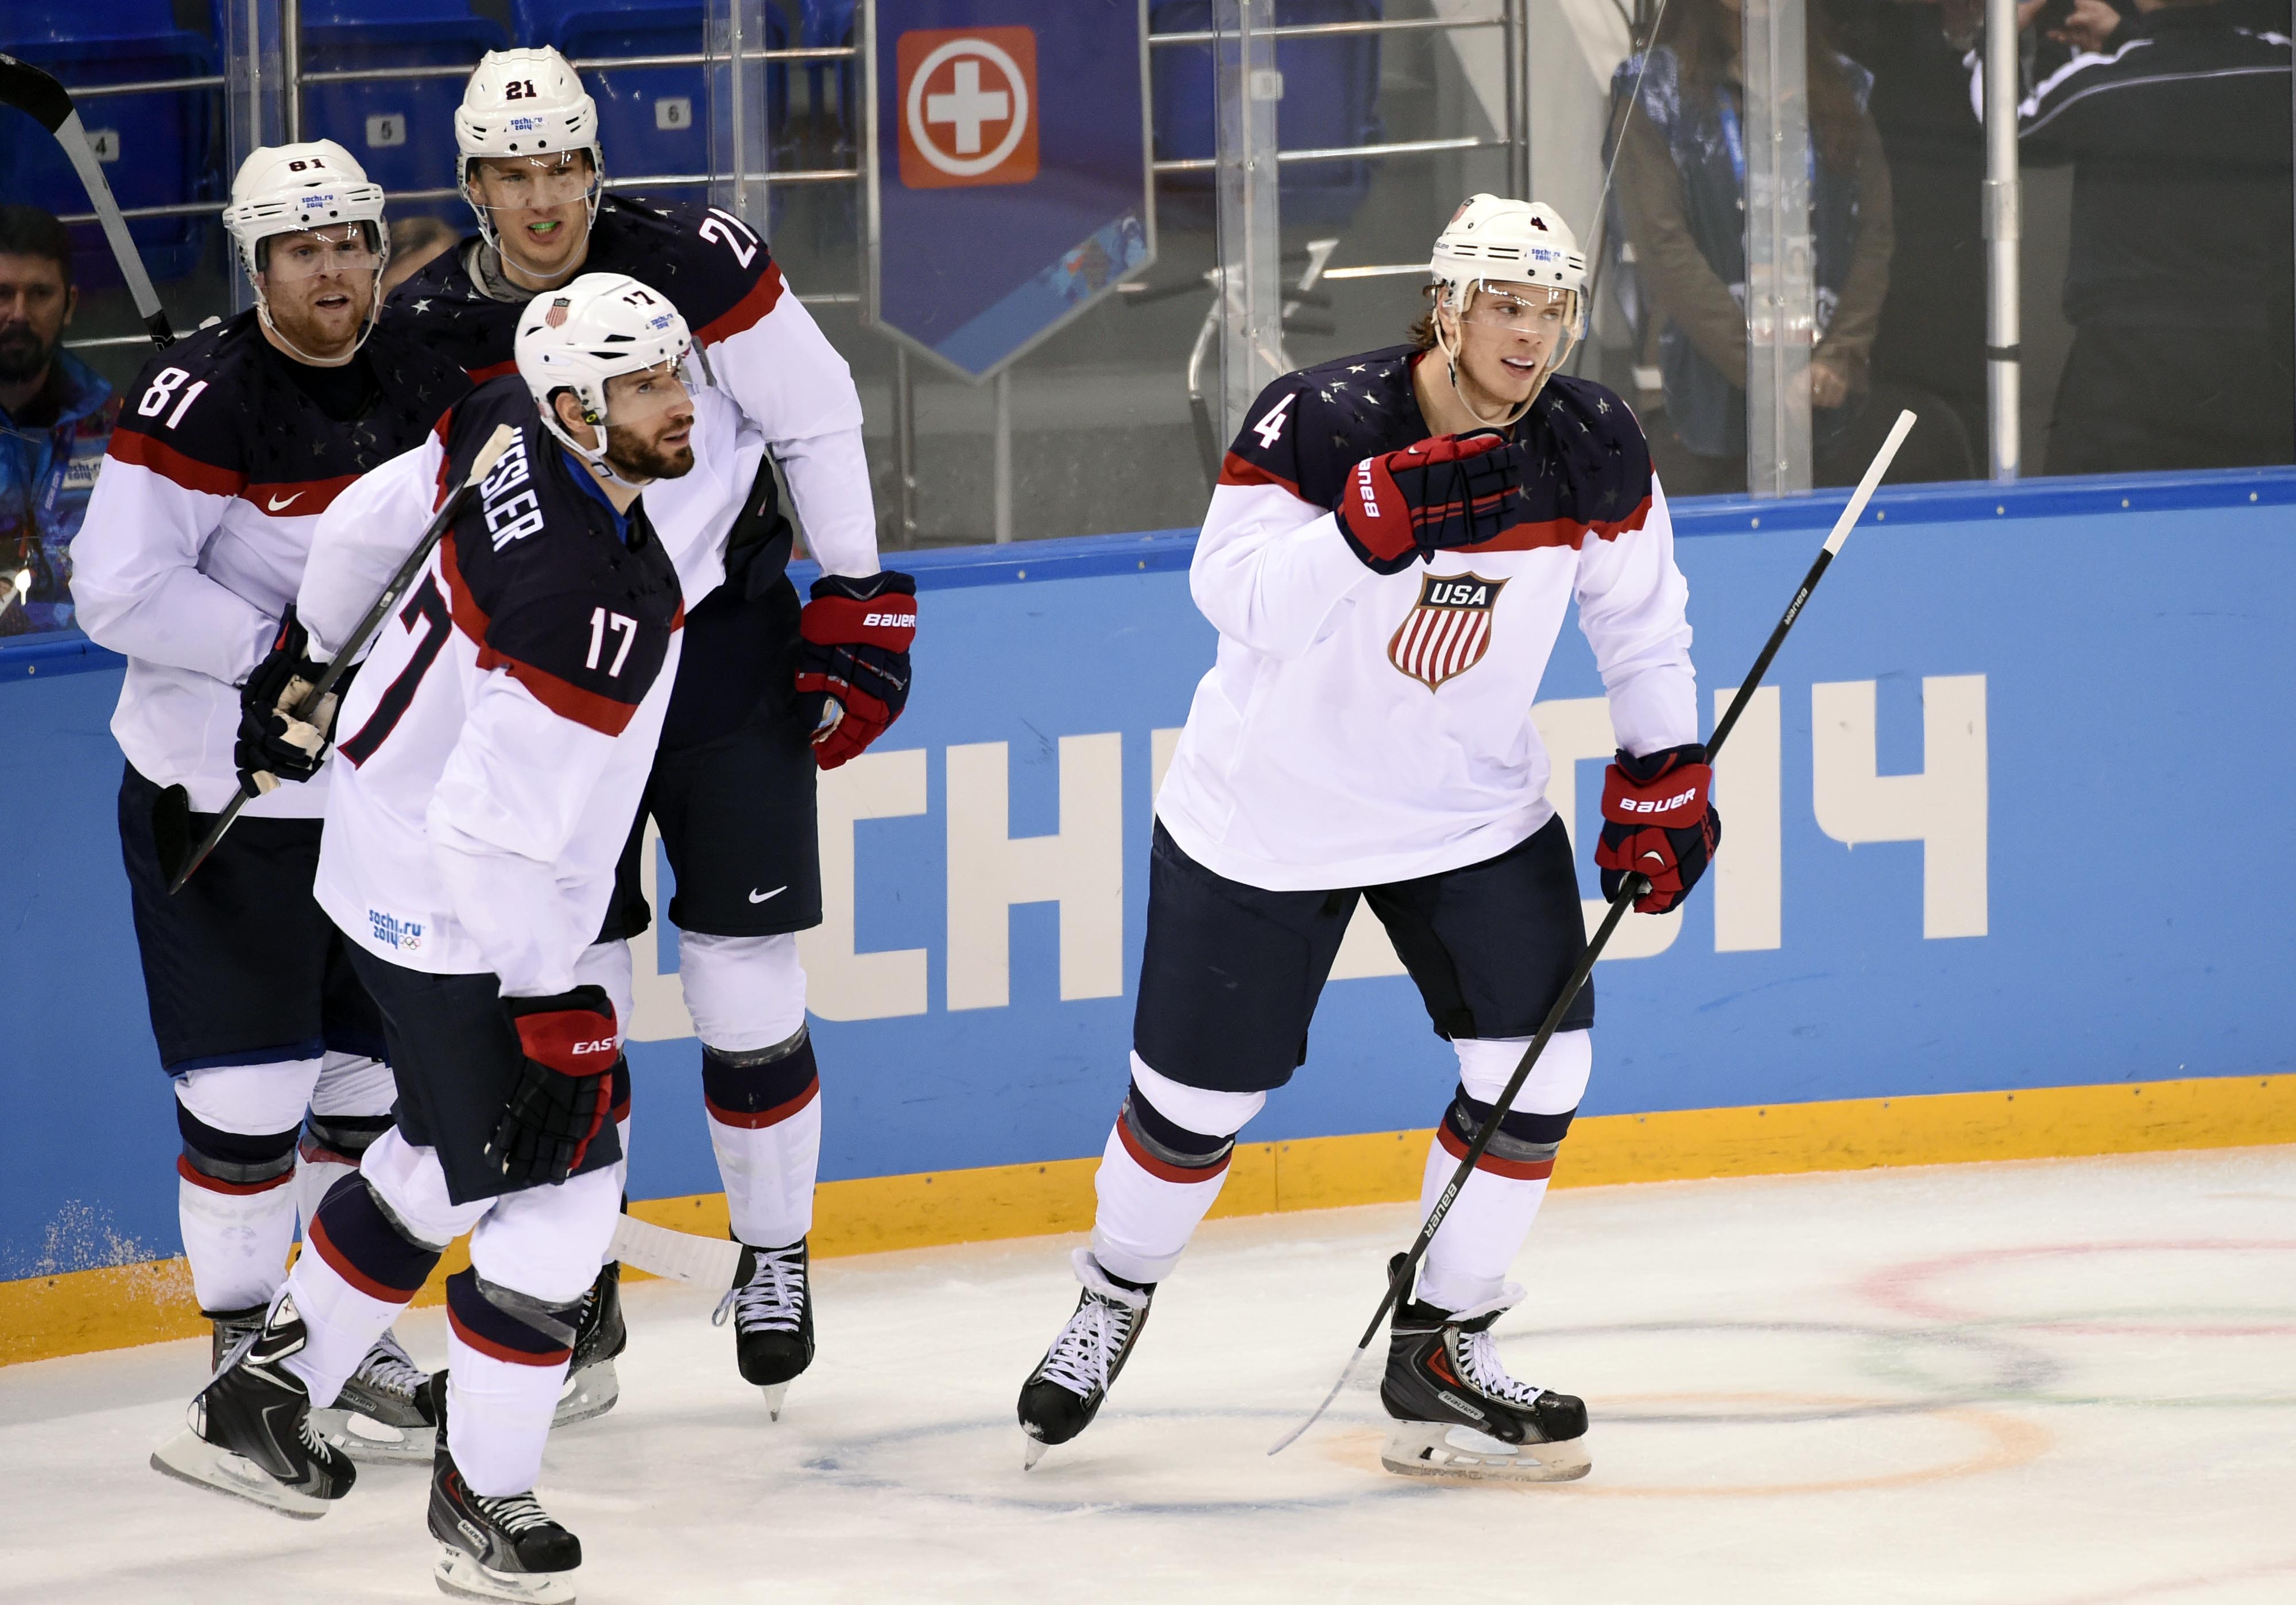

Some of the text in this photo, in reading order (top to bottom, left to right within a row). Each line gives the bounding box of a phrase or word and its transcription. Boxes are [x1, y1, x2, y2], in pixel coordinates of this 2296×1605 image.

[506, 79, 537, 100] 21
[95, 137, 106, 155] 4
[289, 158, 326, 172] 81
[301, 195, 334, 203] sochi.ru
[1531, 216, 1548, 231] 4
[699, 207, 758, 269] 21
[138, 367, 208, 430] 81
[1253, 393, 1296, 449] 4
[1430, 583, 1487, 605] USA
[586, 606, 637, 678] 17
[1620, 787, 1696, 813] BAUER
[369, 909, 421, 937] sochi.ru
[374, 925, 398, 950] 2014
[1424, 1182, 1458, 1238] BAUER
